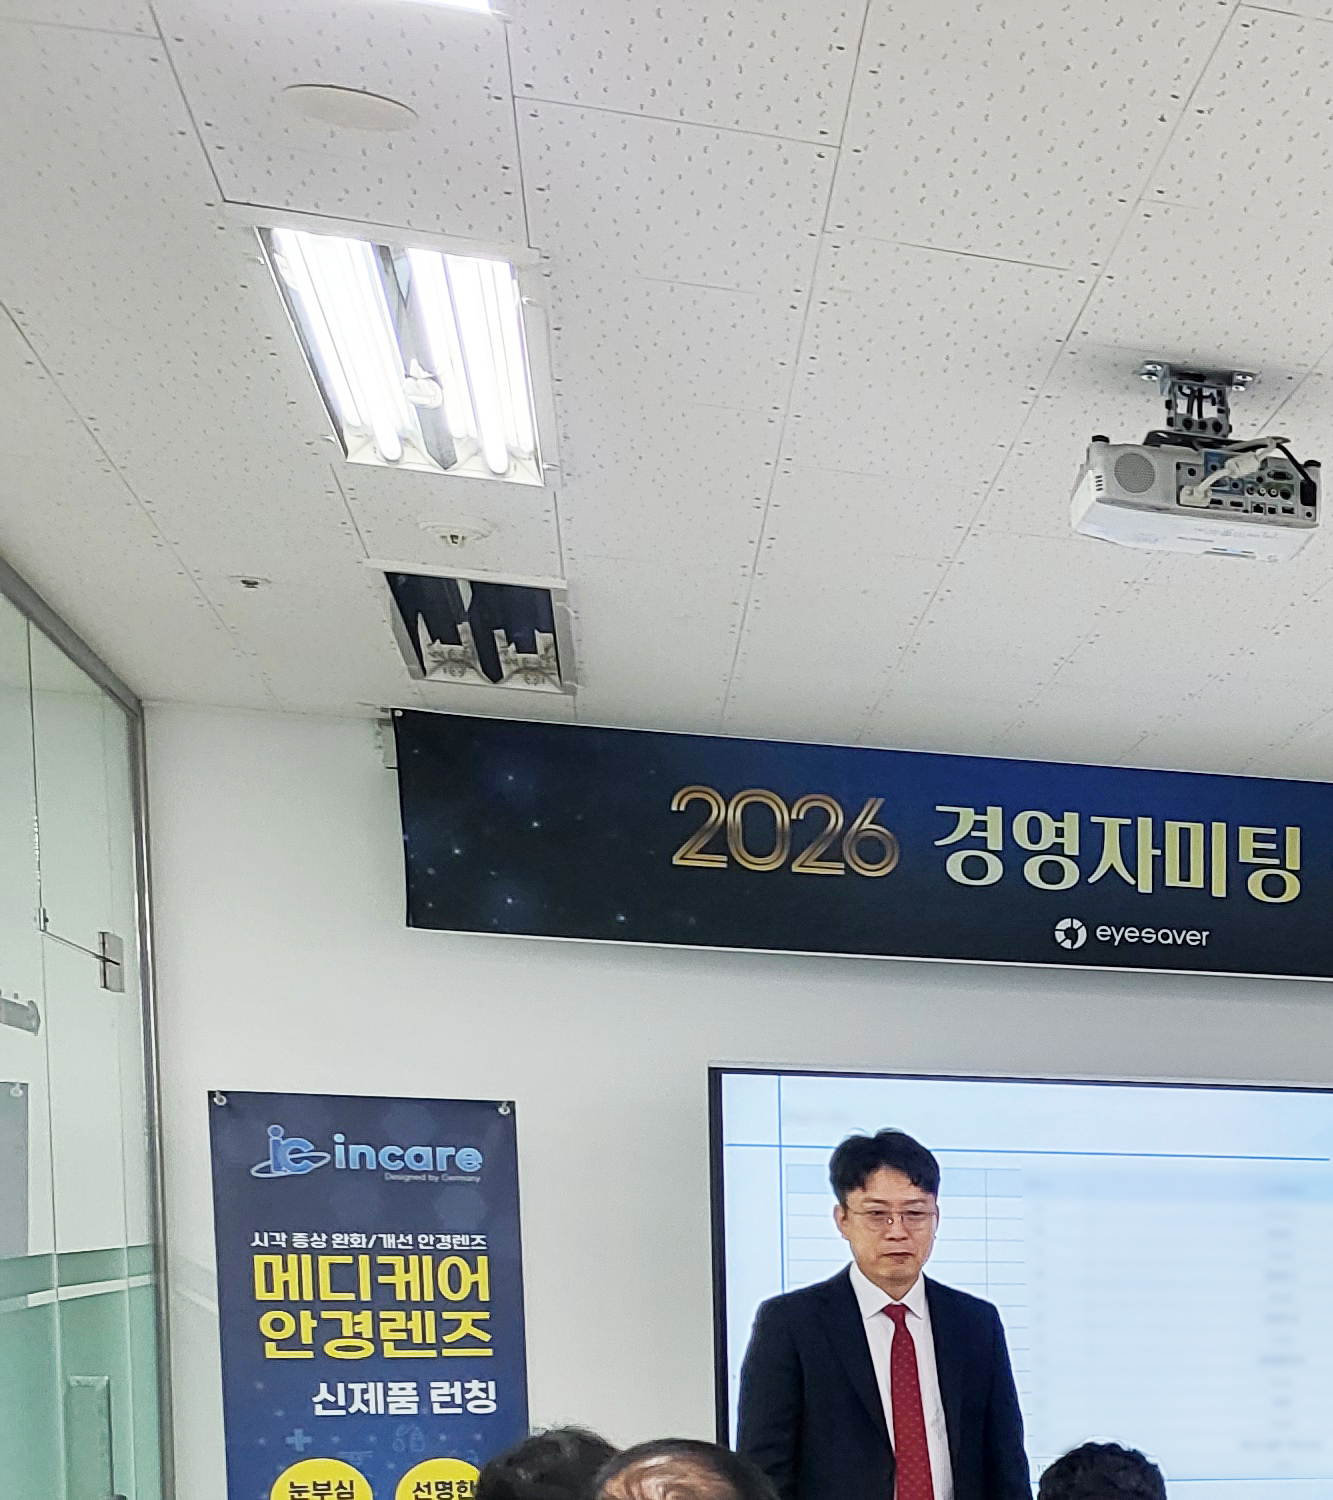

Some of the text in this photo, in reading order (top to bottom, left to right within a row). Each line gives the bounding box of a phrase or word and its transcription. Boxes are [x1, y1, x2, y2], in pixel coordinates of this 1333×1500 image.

[670, 785, 899, 877] 2026
[933, 804, 1302, 905] 경영자미팅
[1096, 921, 1210, 949] eyesaver
[333, 1133, 483, 1173] incare
[250, 1231, 488, 1250] 시각 증상 완화/개선 안경렌즈
[253, 1254, 490, 1302] 메디케어
[259, 1309, 493, 1359] 안경렌즈
[312, 1379, 497, 1416] 신제품 런칭
